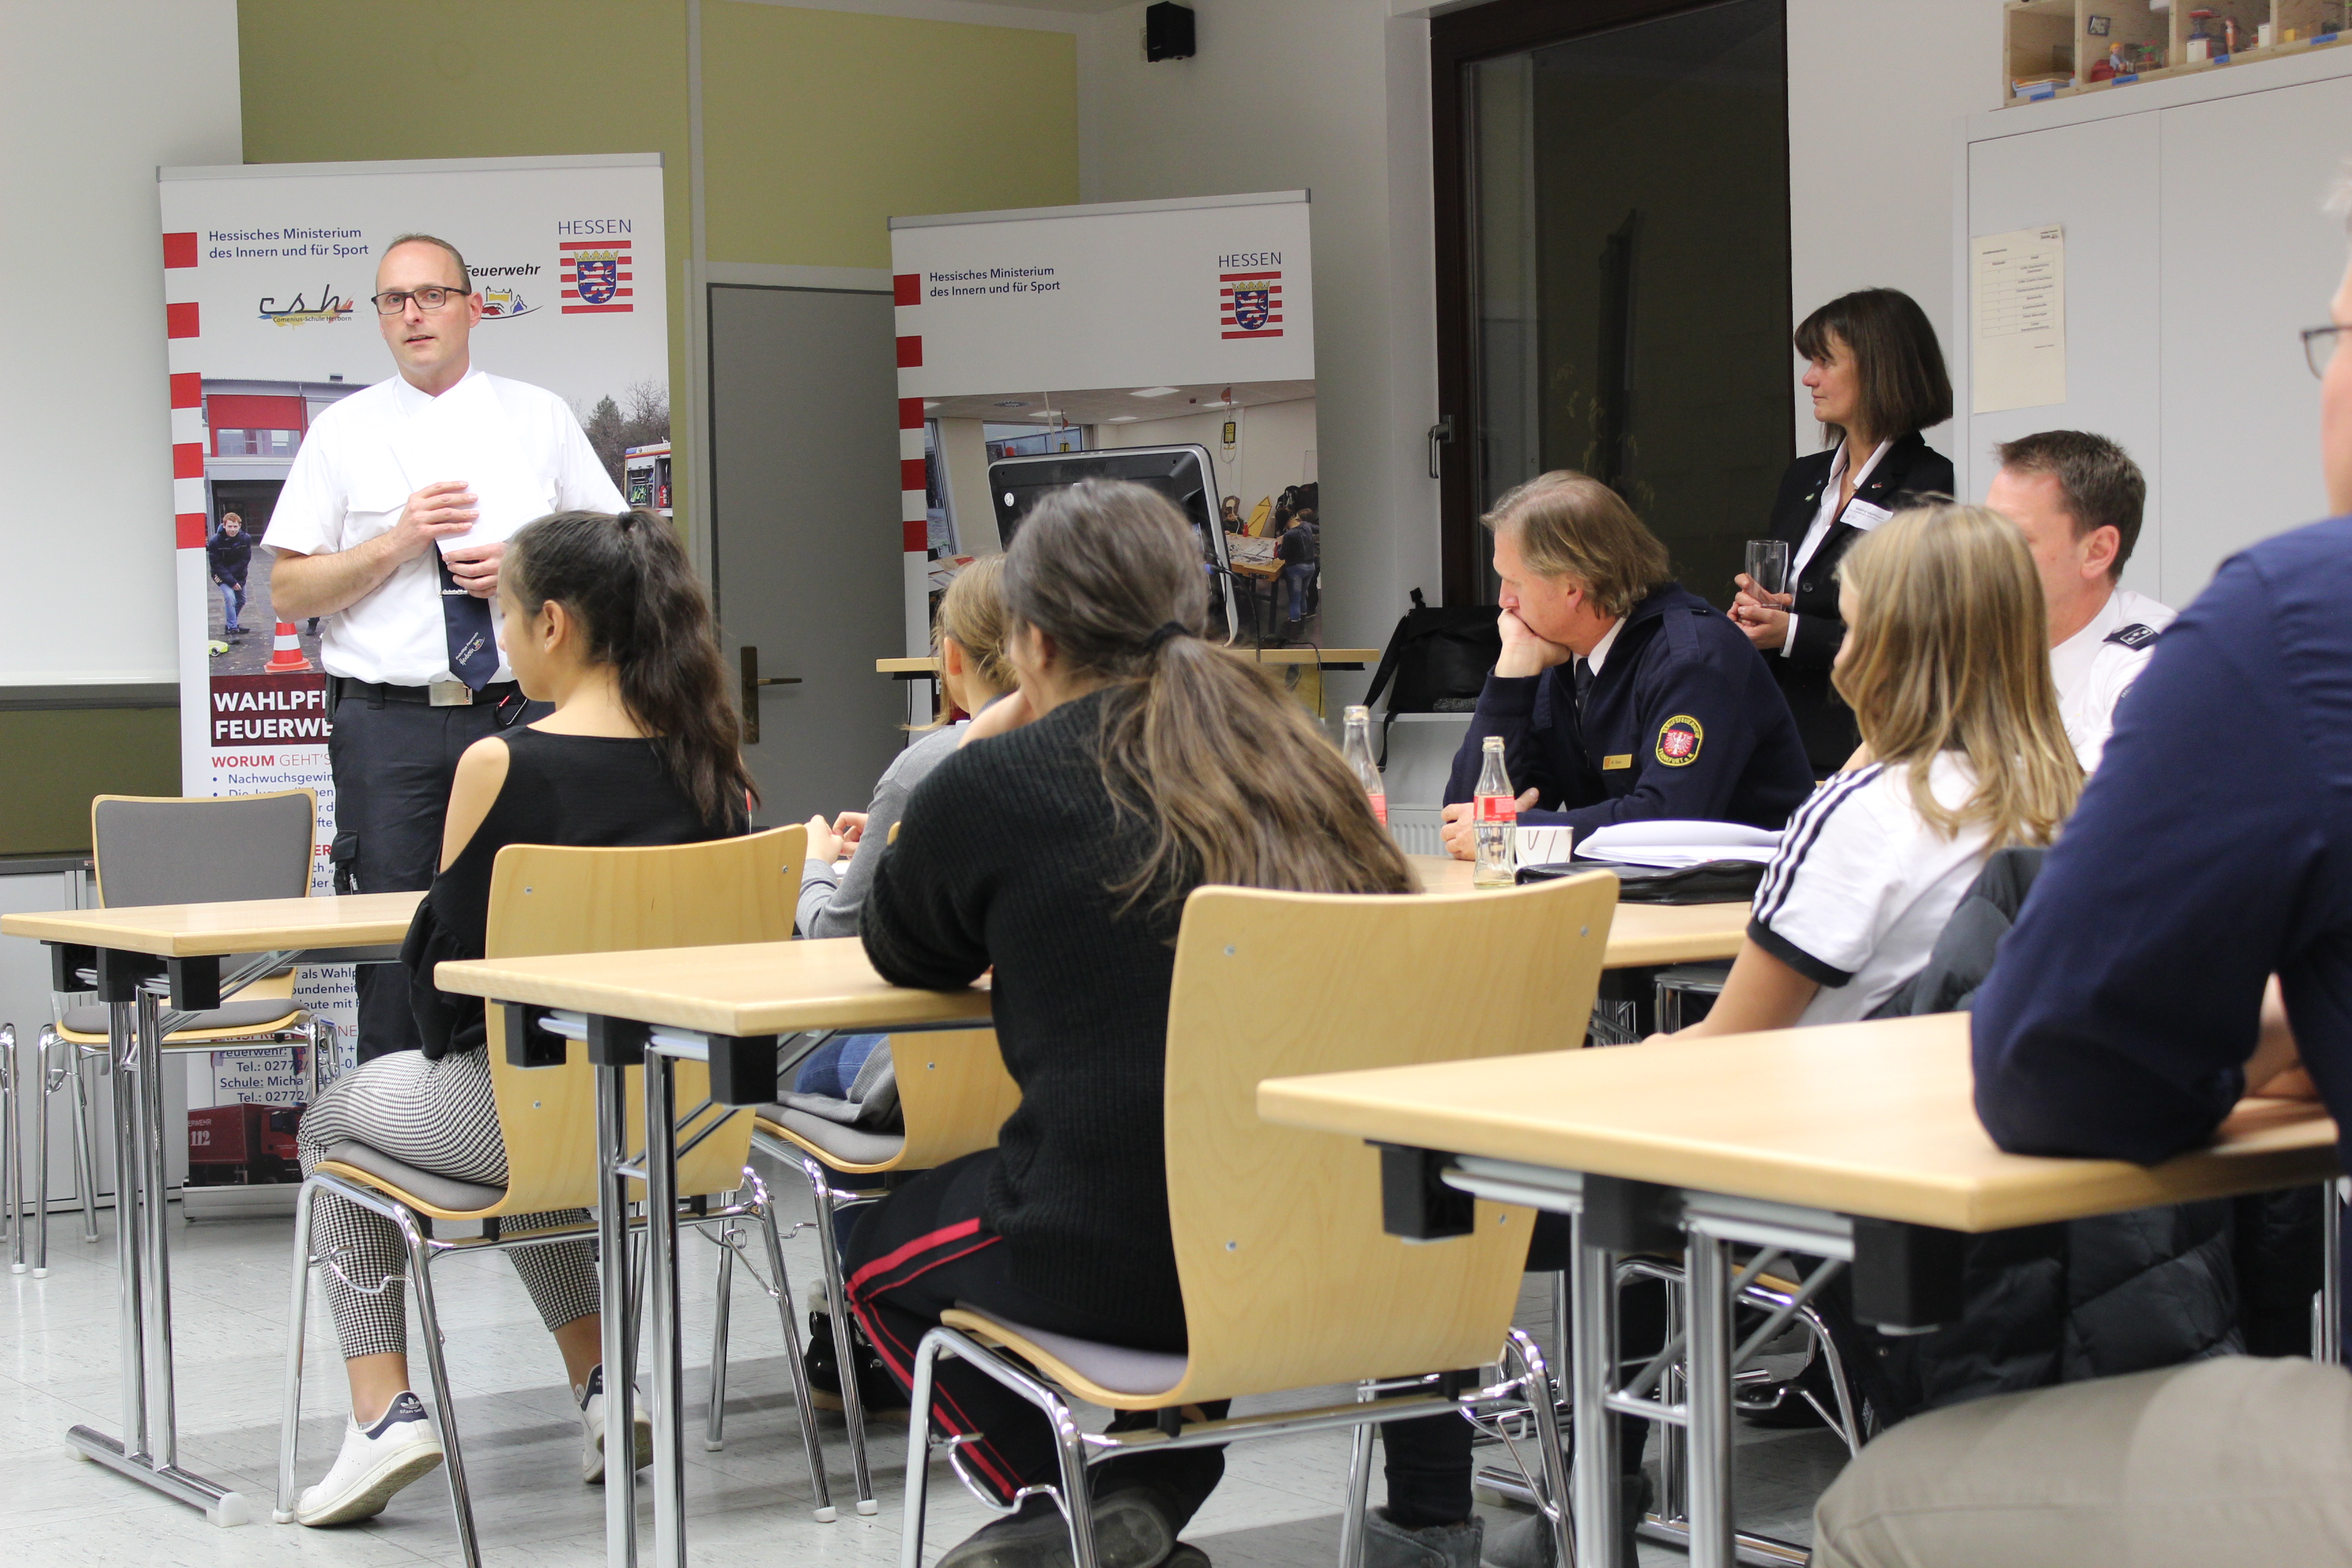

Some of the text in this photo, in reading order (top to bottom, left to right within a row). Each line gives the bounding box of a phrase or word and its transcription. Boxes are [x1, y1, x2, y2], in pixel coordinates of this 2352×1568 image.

[209, 227, 361, 242] Hessisches Ministerium
[558, 219, 632, 235] HESSEN
[209, 244, 369, 259] des Innern und für Sport
[1219, 252, 1281, 268] HESSEN
[930, 266, 1054, 282] Hessisches Ministerium
[930, 281, 1060, 297] des Innern und für Sport
[259, 284, 354, 314] csh
[211, 755, 275, 768] WORUM
[301, 968, 318, 979] als
[333, 998, 353, 1009] mit
[236, 1062, 261, 1072] Tel.:
[220, 1077, 264, 1088] Schule:
[237, 1092, 261, 1102] Tel.:
[191, 1130, 211, 1146] 112
